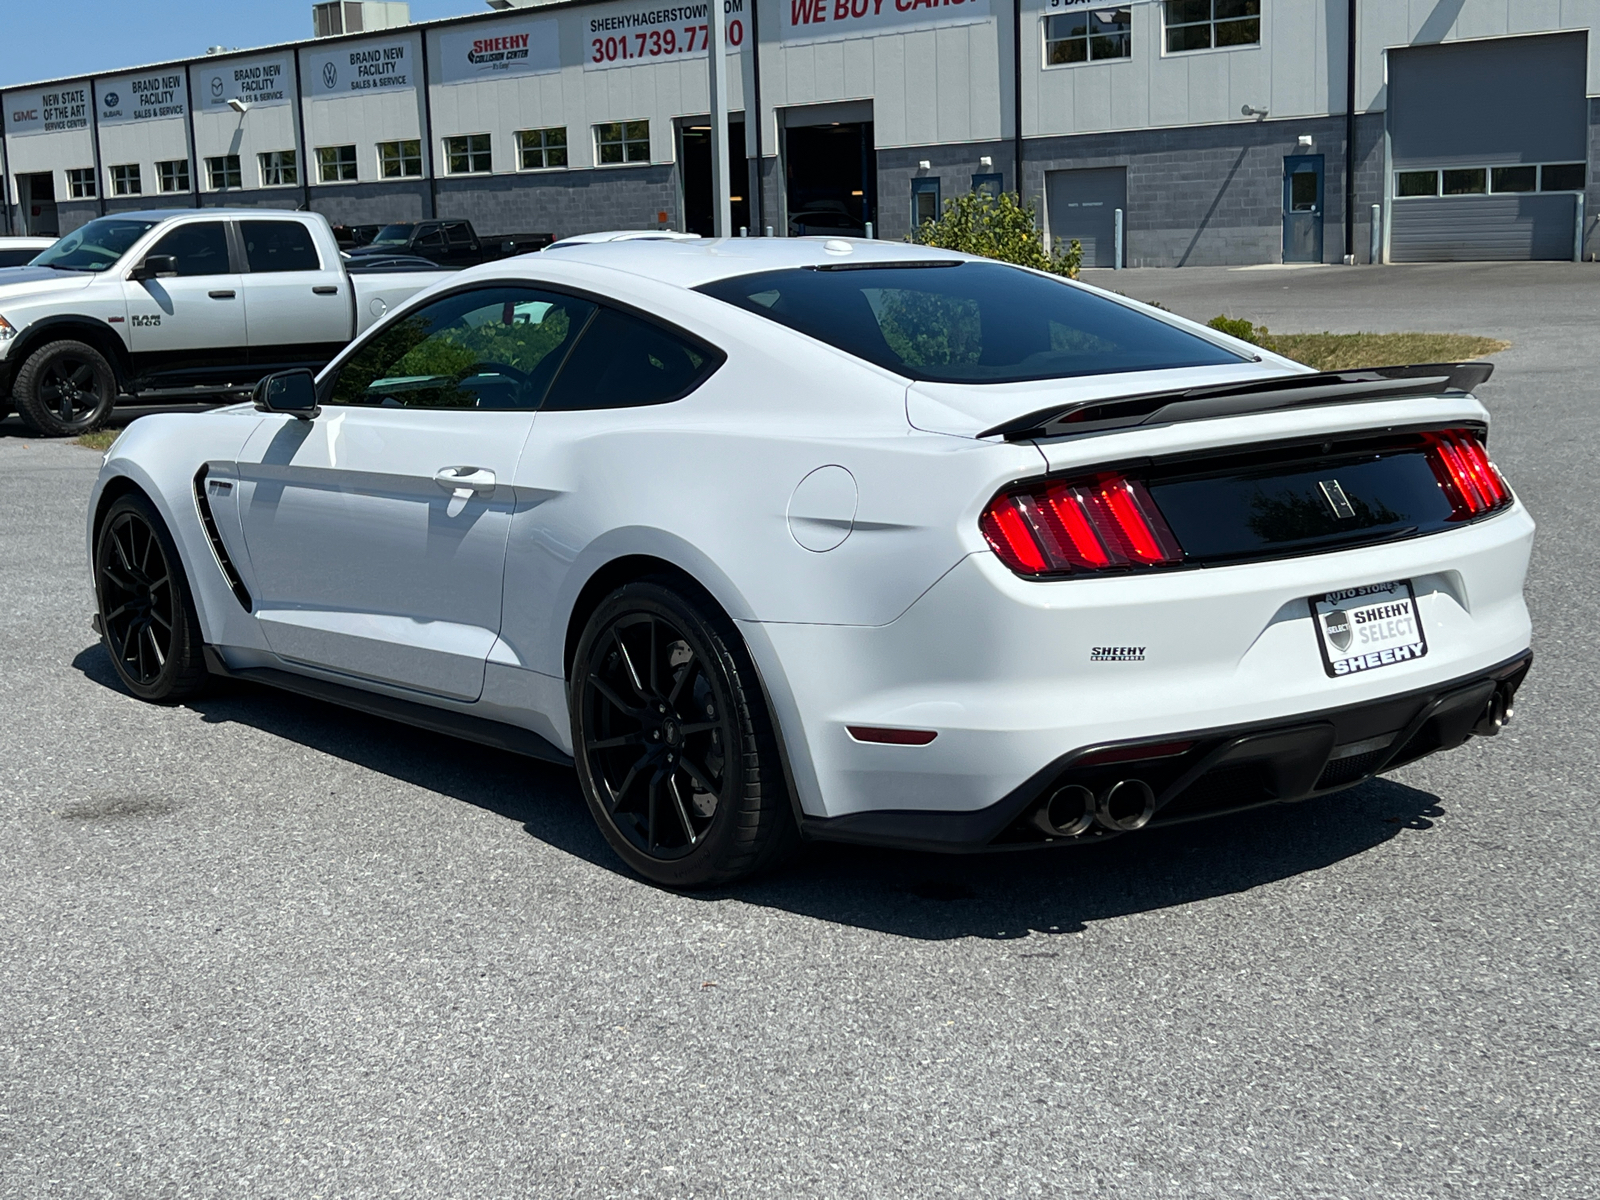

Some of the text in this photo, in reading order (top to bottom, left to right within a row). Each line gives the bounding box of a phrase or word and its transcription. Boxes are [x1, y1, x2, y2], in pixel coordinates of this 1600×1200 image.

[791, 0, 827, 26] WE
[473, 34, 530, 54] SHEEHY
[592, 19, 744, 63] 301.739.770
[350, 46, 404, 66] BRAND NEW
[474, 49, 530, 64] COLLISION CENTER
[234, 64, 281, 81] BRAND NEW
[358, 61, 397, 77] FACILITY
[132, 75, 181, 94] BRAND NEW
[241, 78, 275, 93] FACILITY
[351, 75, 407, 90] SALES & SERVICE
[42, 90, 85, 107] NEW STATE
[140, 90, 175, 107] FACILITY
[254, 94, 259, 102] &
[260, 91, 283, 102] SERVICE
[13, 109, 38, 122] GMC
[43, 104, 86, 121] OF THE ART
[134, 105, 184, 119] SALES & SERVICE
[44, 118, 87, 131] SERVICE CENTER
[1324, 581, 1401, 603] AUTO STORES
[1354, 602, 1409, 624] SHEEHY
[1327, 623, 1349, 635] SELECT
[1359, 617, 1413, 644] SELECT
[1091, 646, 1147, 656] SHEEHY
[1333, 642, 1424, 675] SHEEHY
